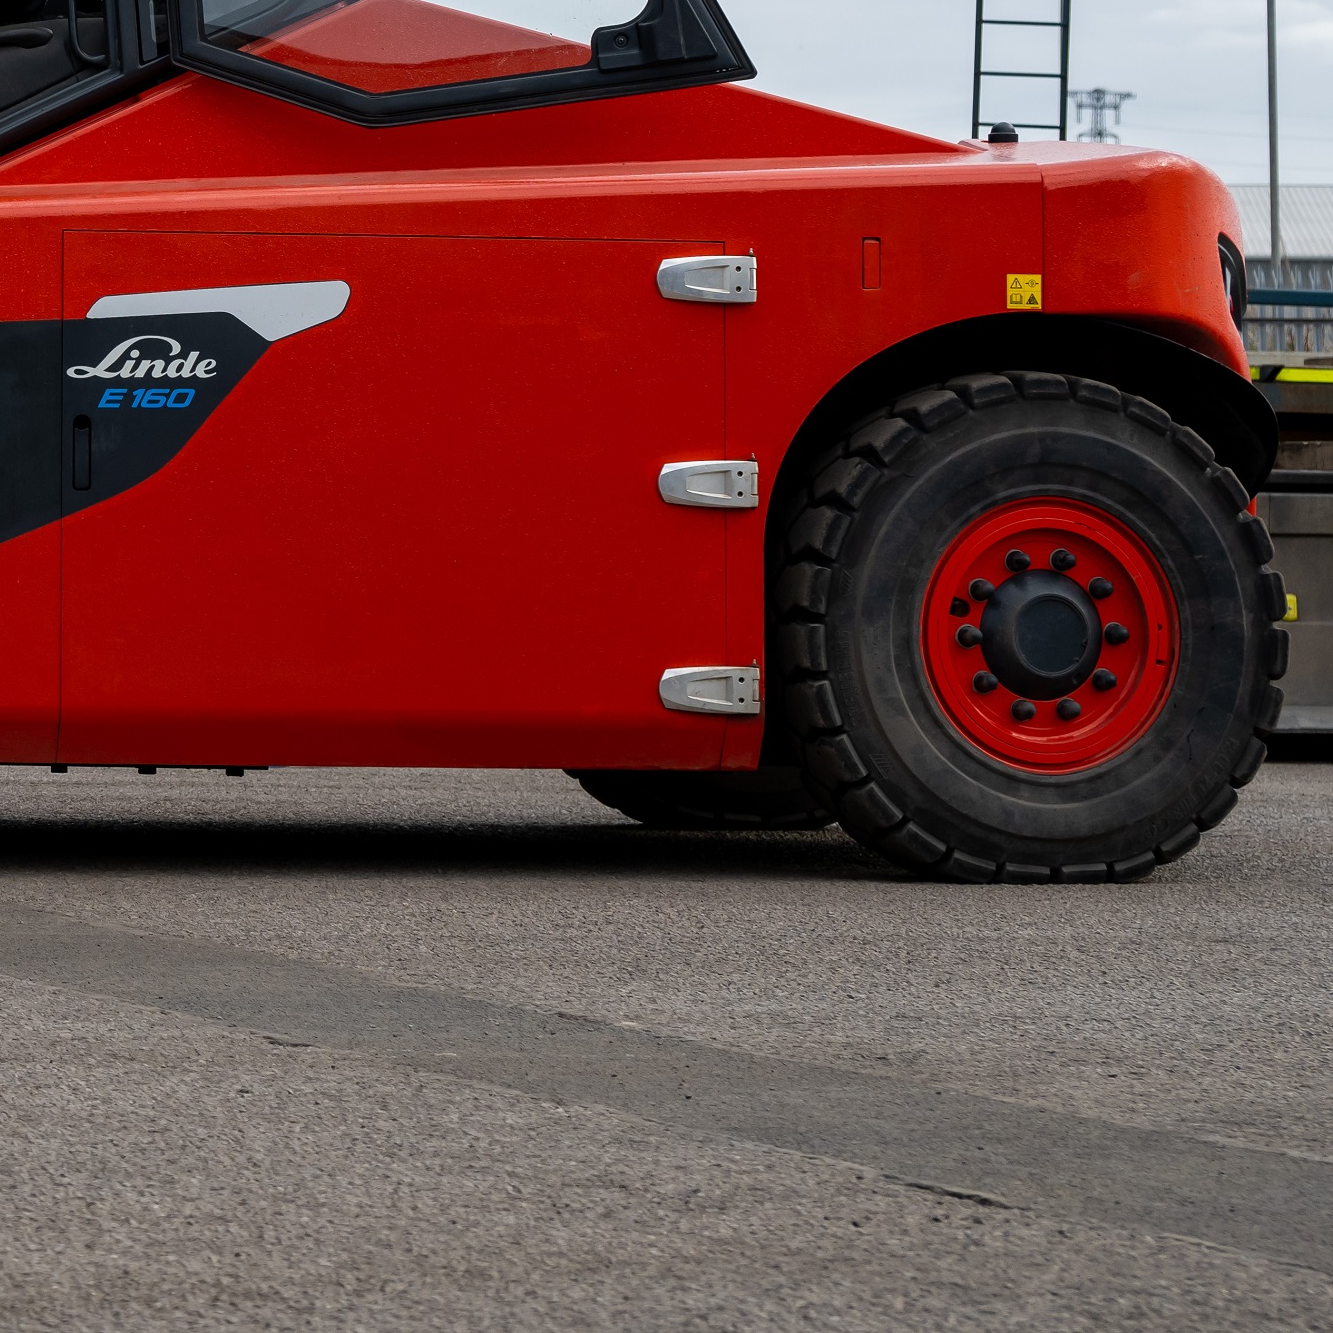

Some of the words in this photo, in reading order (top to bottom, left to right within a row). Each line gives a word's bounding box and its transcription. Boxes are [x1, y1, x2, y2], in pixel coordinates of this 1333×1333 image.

[66, 335, 217, 379] Linde
[97, 388, 128, 408] E
[131, 388, 196, 408] 160
